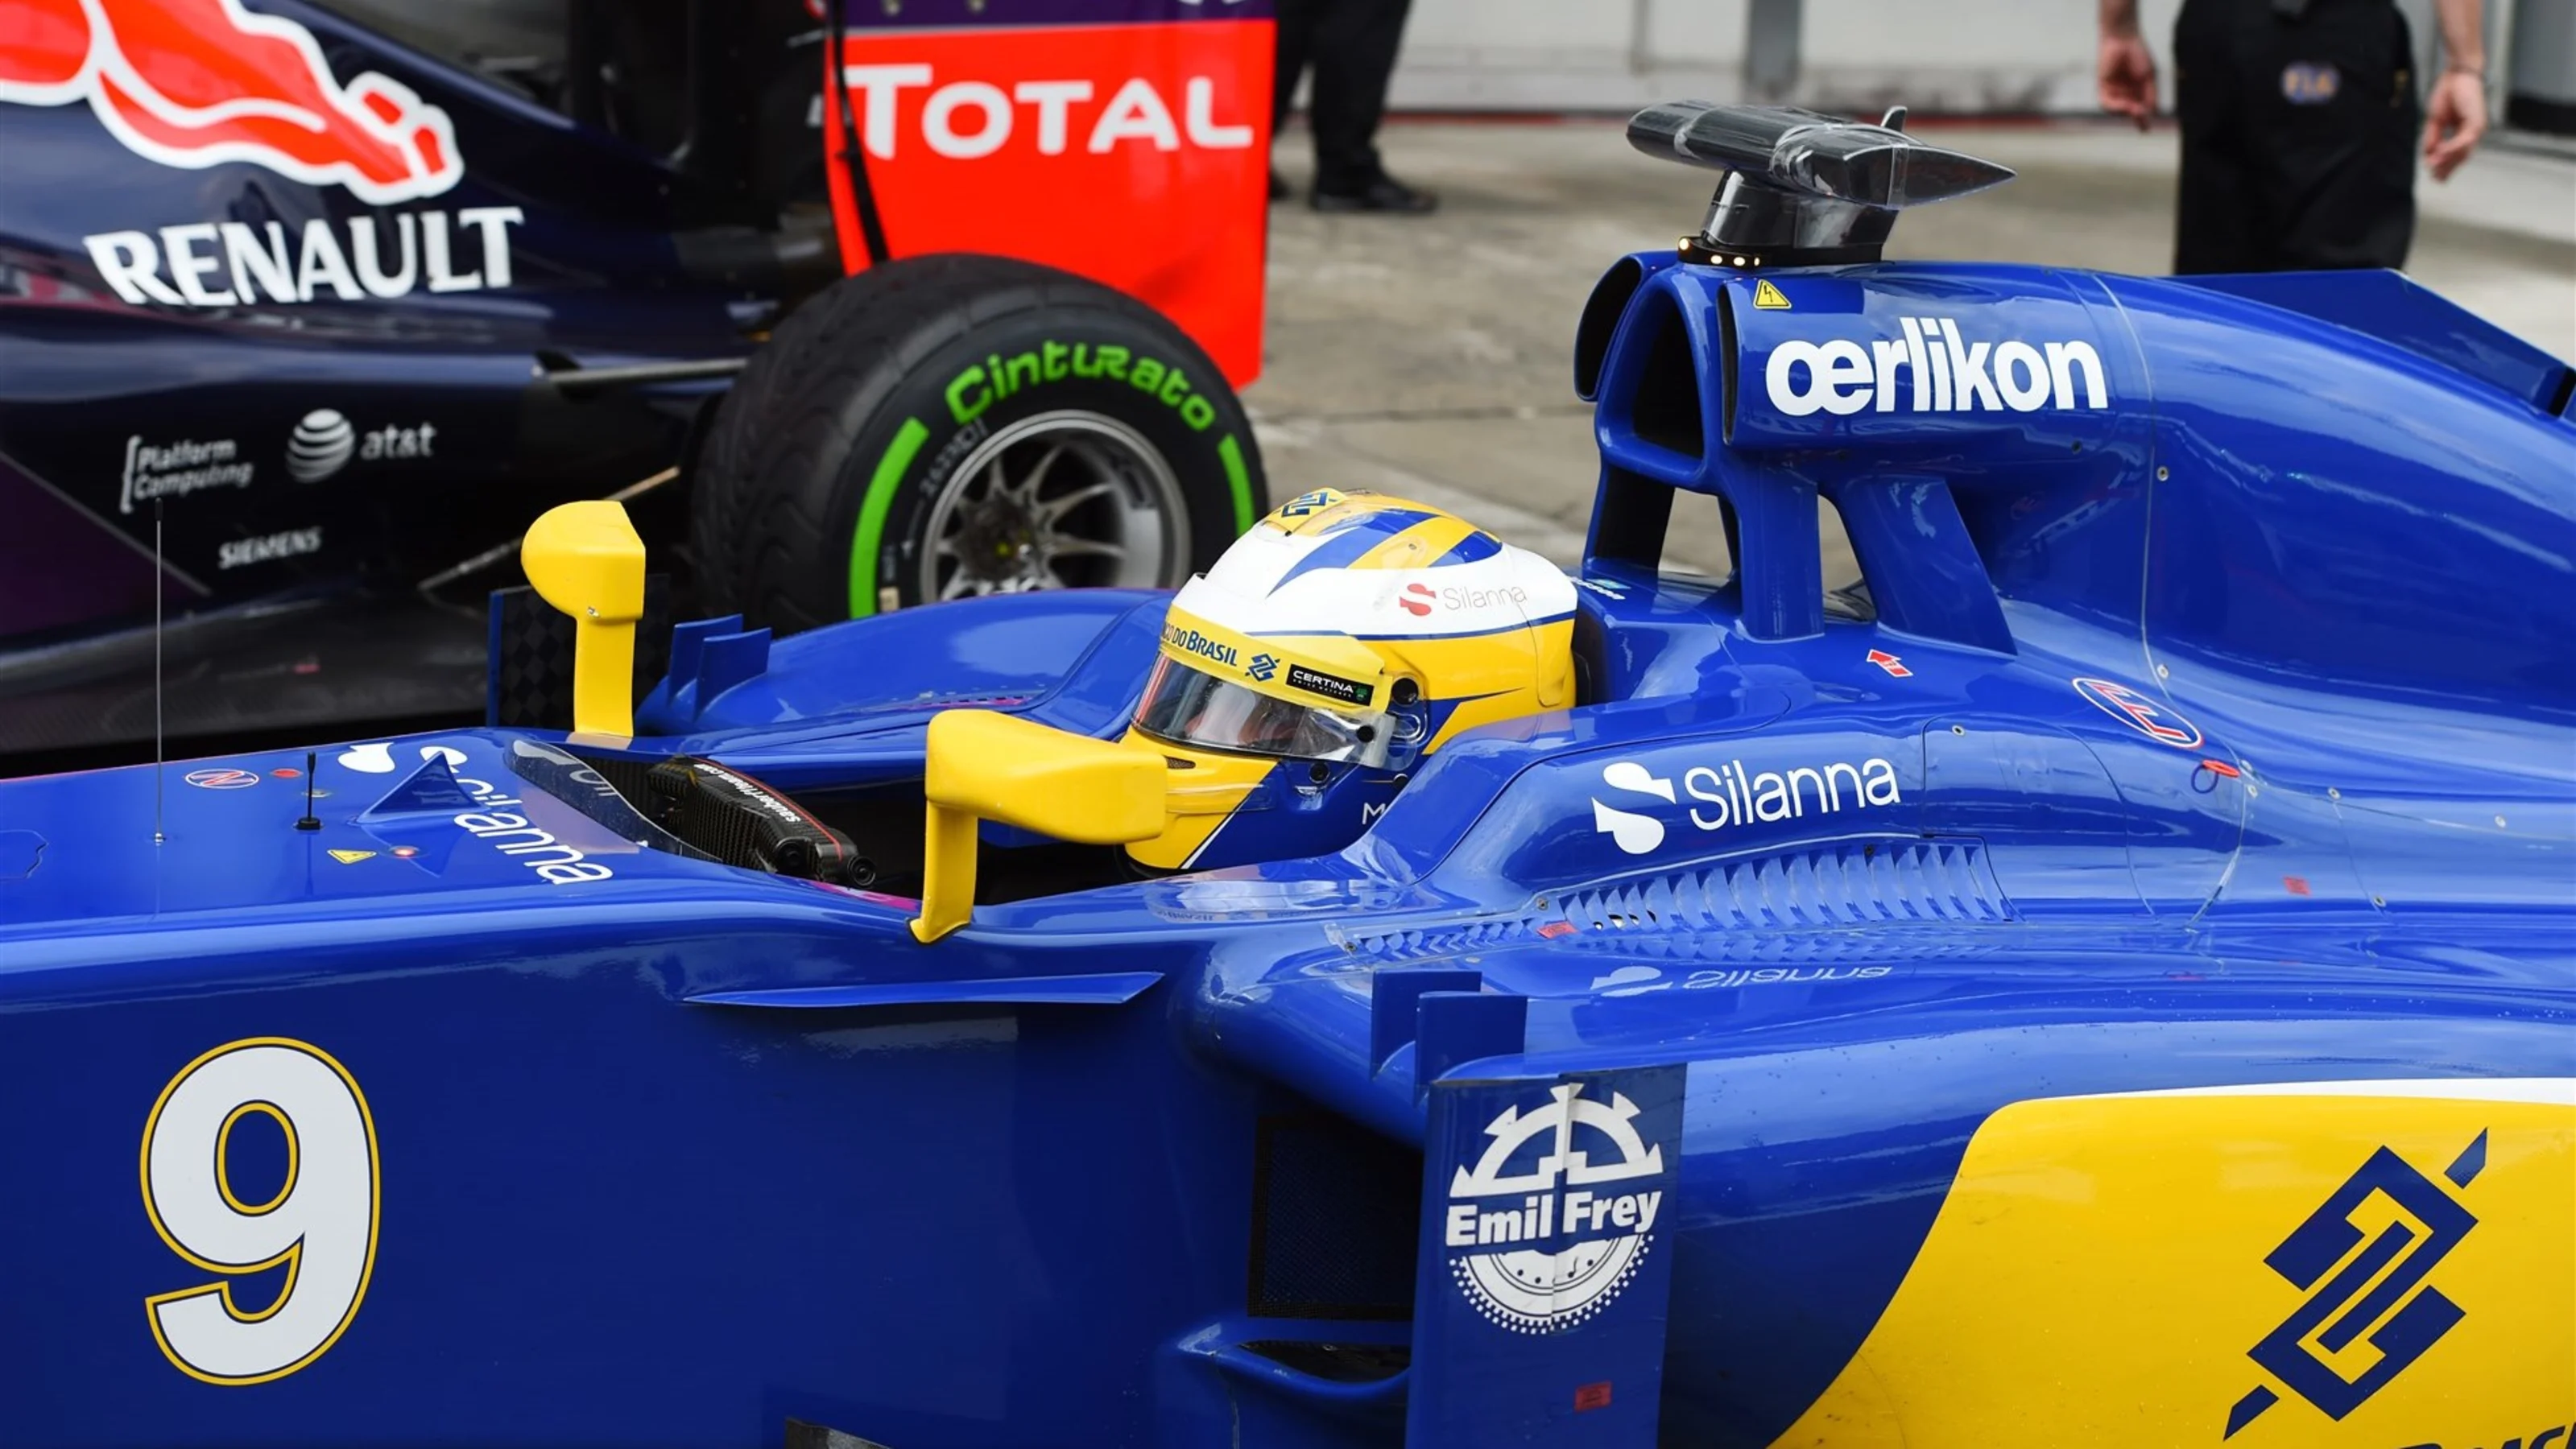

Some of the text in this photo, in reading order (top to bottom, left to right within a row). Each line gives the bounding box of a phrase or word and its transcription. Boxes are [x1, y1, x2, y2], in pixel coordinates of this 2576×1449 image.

[837, 63, 1254, 160] TOTAL
[85, 207, 525, 306] RENAULT
[138, 438, 237, 474] Platform
[361, 421, 436, 461] at&t
[133, 462, 254, 500] Computing
[218, 526, 323, 570] SIEMENS
[1442, 586, 1528, 611] Silanna
[1172, 627, 1188, 647] DO
[1186, 630, 1238, 667] BRASIL
[1292, 670, 1354, 693] CERTINA
[1684, 759, 1901, 831] Silanna
[140, 1036, 380, 1386] 9
[1445, 1191, 1662, 1246] Emil Frey
